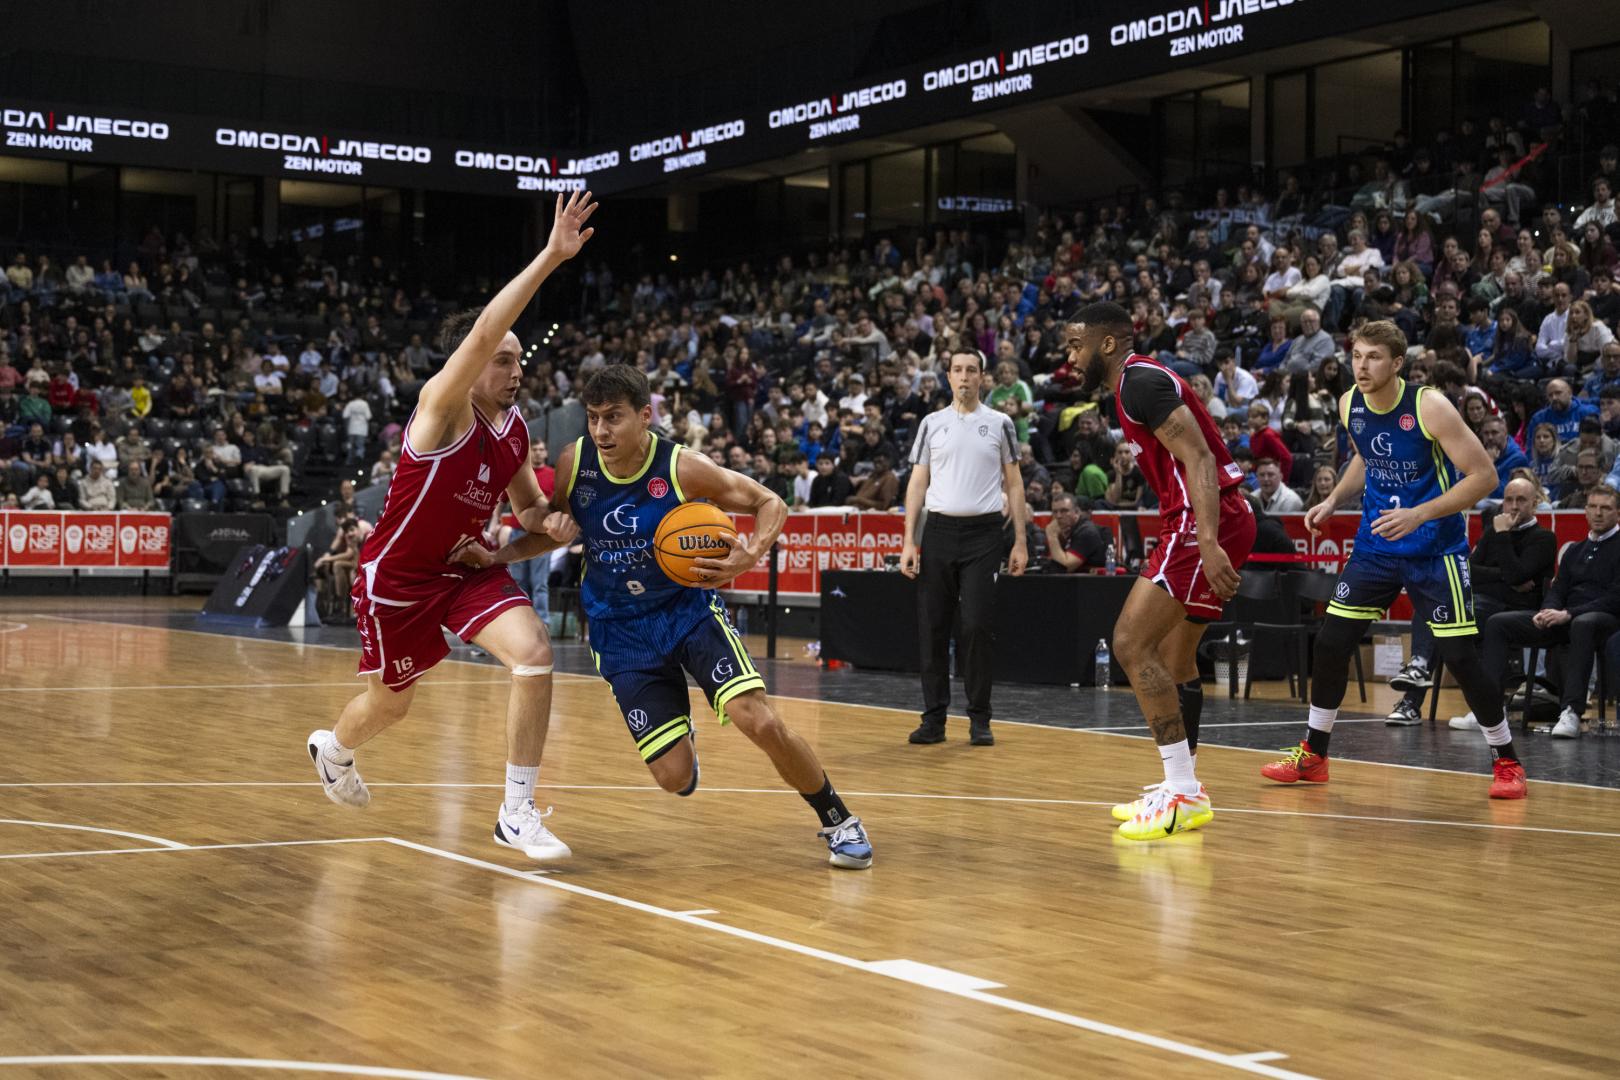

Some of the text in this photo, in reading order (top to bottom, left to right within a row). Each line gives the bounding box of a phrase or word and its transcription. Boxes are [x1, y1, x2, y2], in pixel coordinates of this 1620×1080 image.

[1110, 6, 1202, 47] OMODA
[1170, 24, 1243, 57] ZEN MOTOR
[923, 34, 1089, 91] OMODA JAECOO
[972, 73, 1032, 102] ZEN MOTOR
[769, 79, 907, 129] OMODA JAECOO
[0, 109, 169, 140] DA JAECOO
[809, 114, 860, 140] ZEN MOTOR
[6, 131, 93, 152] ZEN MOTOR
[216, 128, 432, 163] OMODA JAECOO
[629, 119, 745, 162] OMODA JAECOO
[284, 155, 363, 175] ZEN MOTOR
[455, 151, 620, 175] OMODA JAECOO
[517, 175, 543, 191] ZEN
[1403, 461, 1418, 470] DE
[462, 480, 492, 505] Jaén
[626, 580, 646, 596] 9
[392, 656, 413, 674] 16
